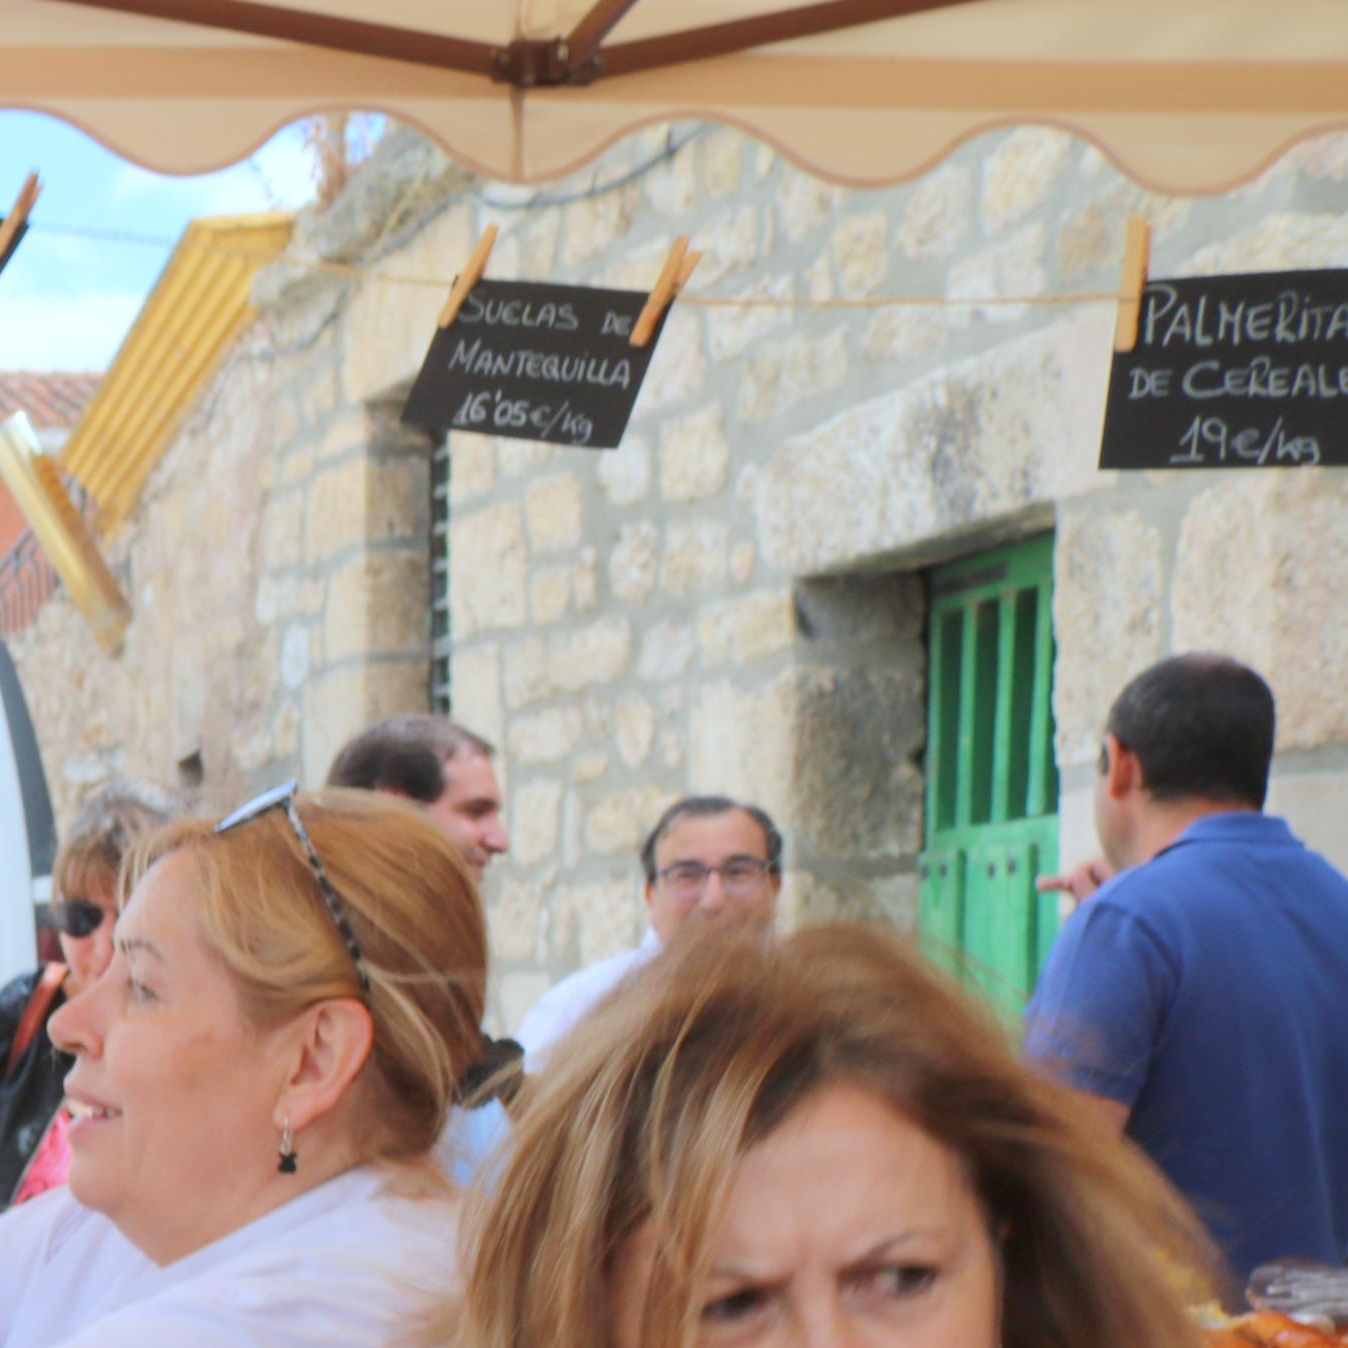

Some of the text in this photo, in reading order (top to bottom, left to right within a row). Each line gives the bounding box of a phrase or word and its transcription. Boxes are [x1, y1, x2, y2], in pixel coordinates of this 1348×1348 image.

[459, 287, 633, 336] SUELAS DE
[1129, 367, 1173, 399] DE
